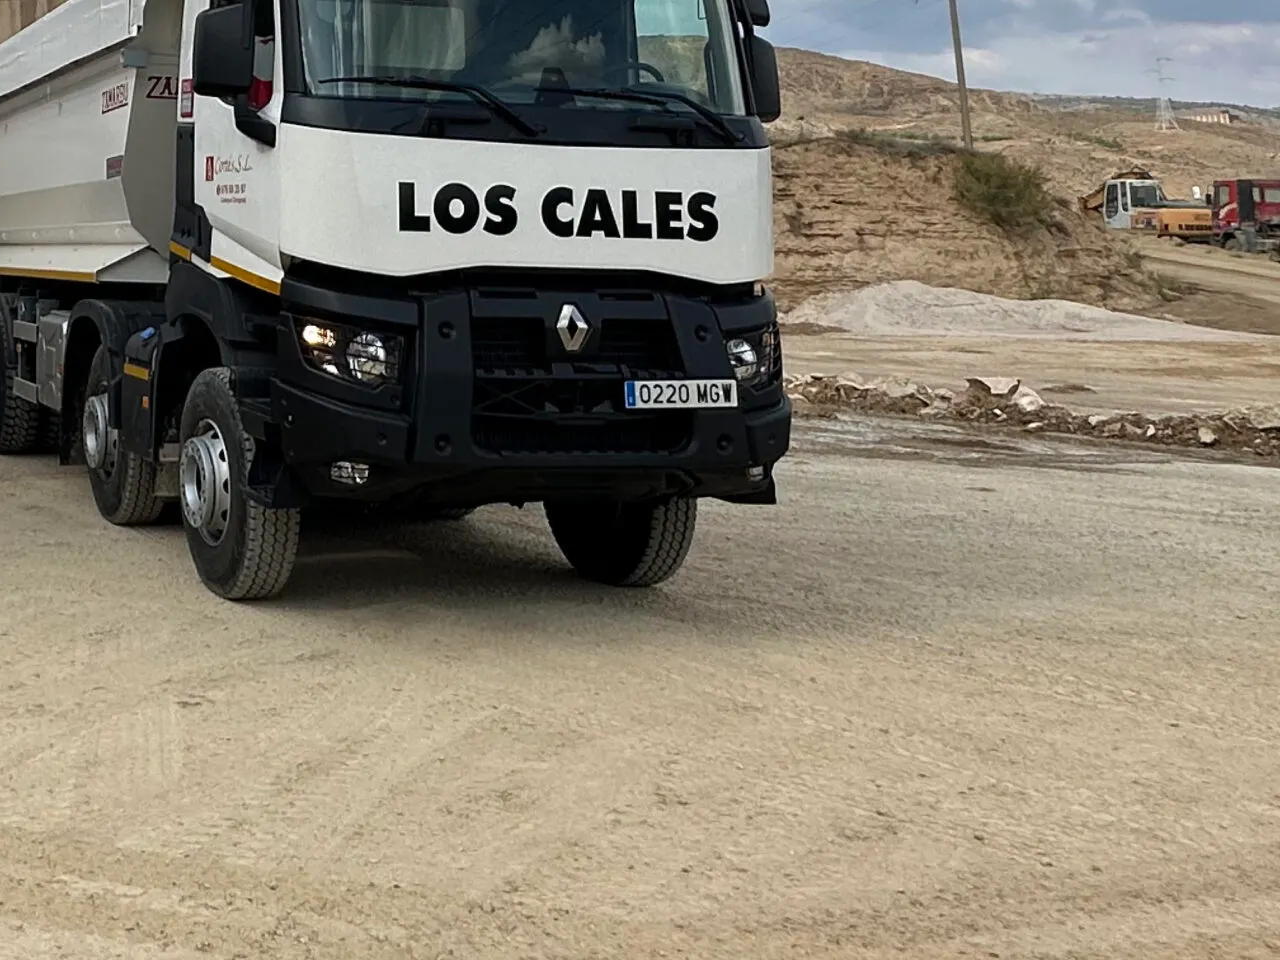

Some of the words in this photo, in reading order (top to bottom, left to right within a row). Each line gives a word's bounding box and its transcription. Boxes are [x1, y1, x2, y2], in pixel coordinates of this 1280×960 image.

[146, 76, 178, 99] ZA
[398, 182, 518, 236] LOS
[541, 186, 719, 242] CALES
[639, 384, 690, 403] 0220
[697, 383, 732, 403] MGW
